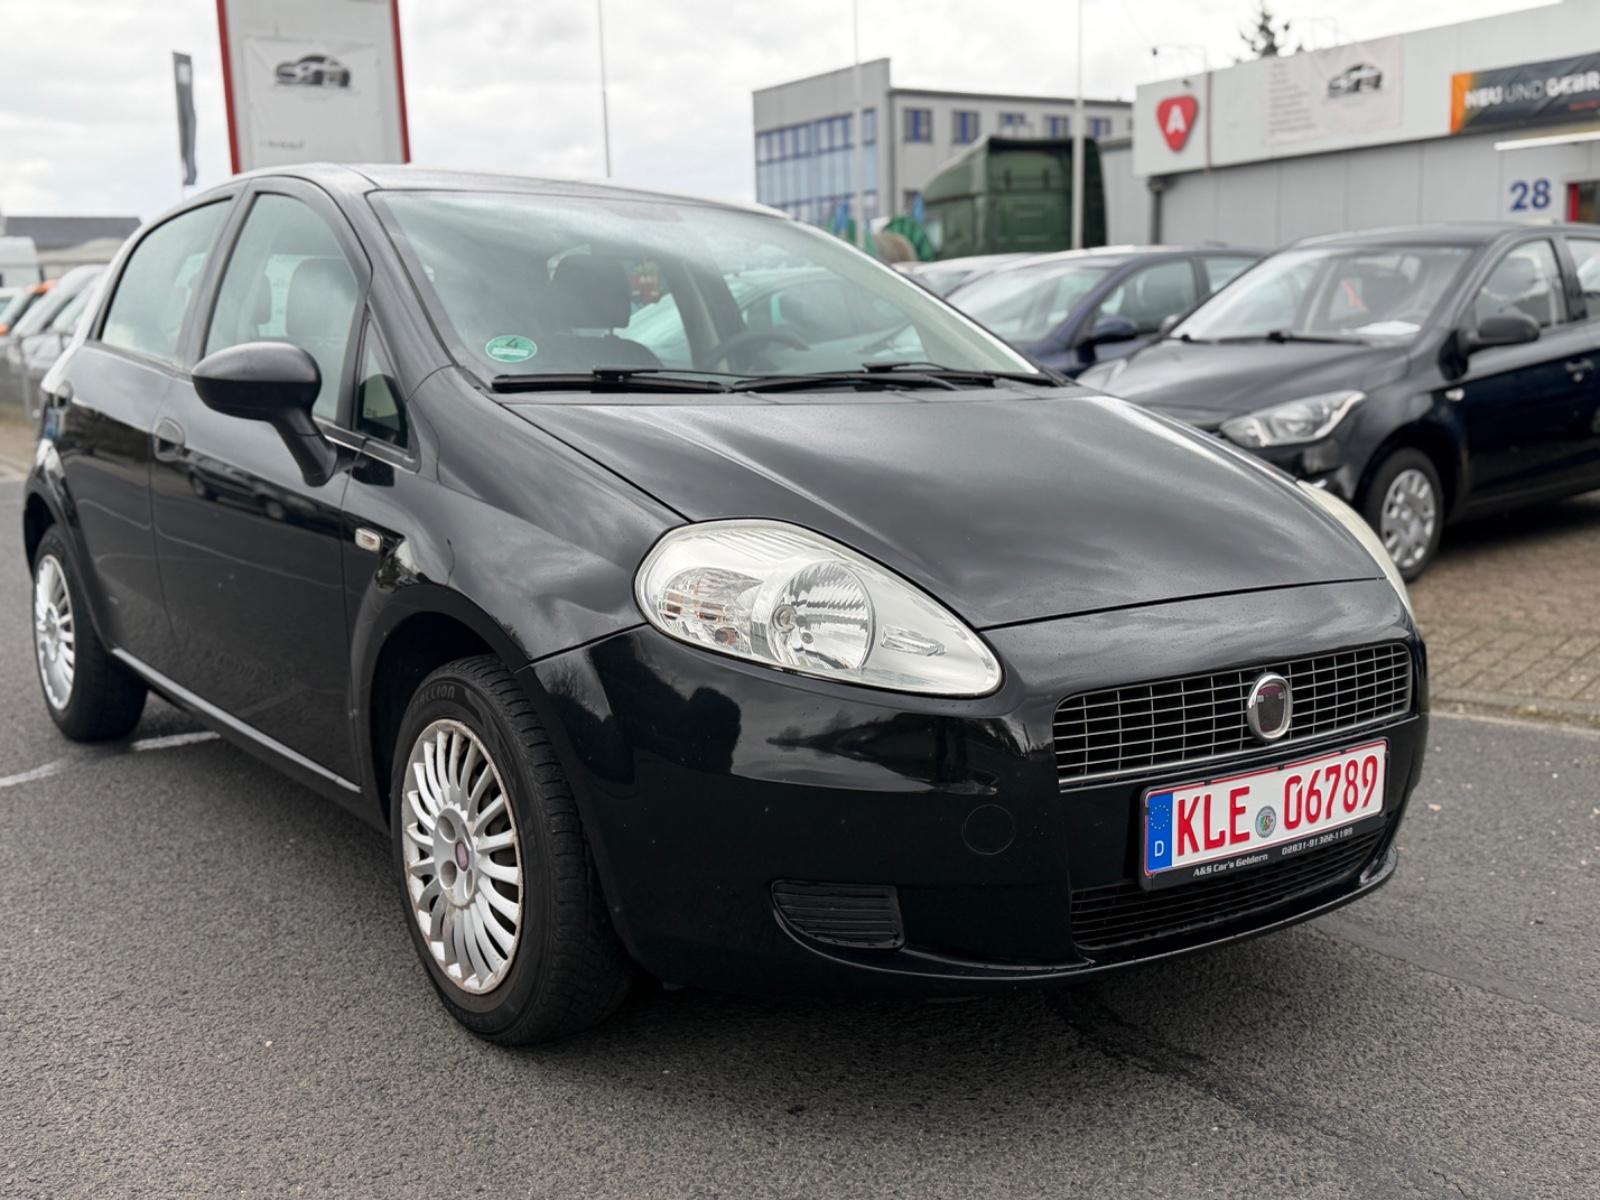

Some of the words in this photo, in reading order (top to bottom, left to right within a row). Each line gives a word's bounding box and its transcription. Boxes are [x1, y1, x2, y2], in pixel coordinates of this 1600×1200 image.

[1464, 85, 1503, 109] NEU
[1504, 80, 1544, 103] UND
[1166, 103, 1187, 135] A
[1510, 178, 1551, 211] 28
[1177, 786, 1250, 856] KLE
[1283, 754, 1378, 831] 06789
[1154, 839, 1165, 857] D
[1192, 864, 1212, 877] A&S
[1213, 860, 1234, 873] Car's
[1235, 853, 1269, 867] Geldern
